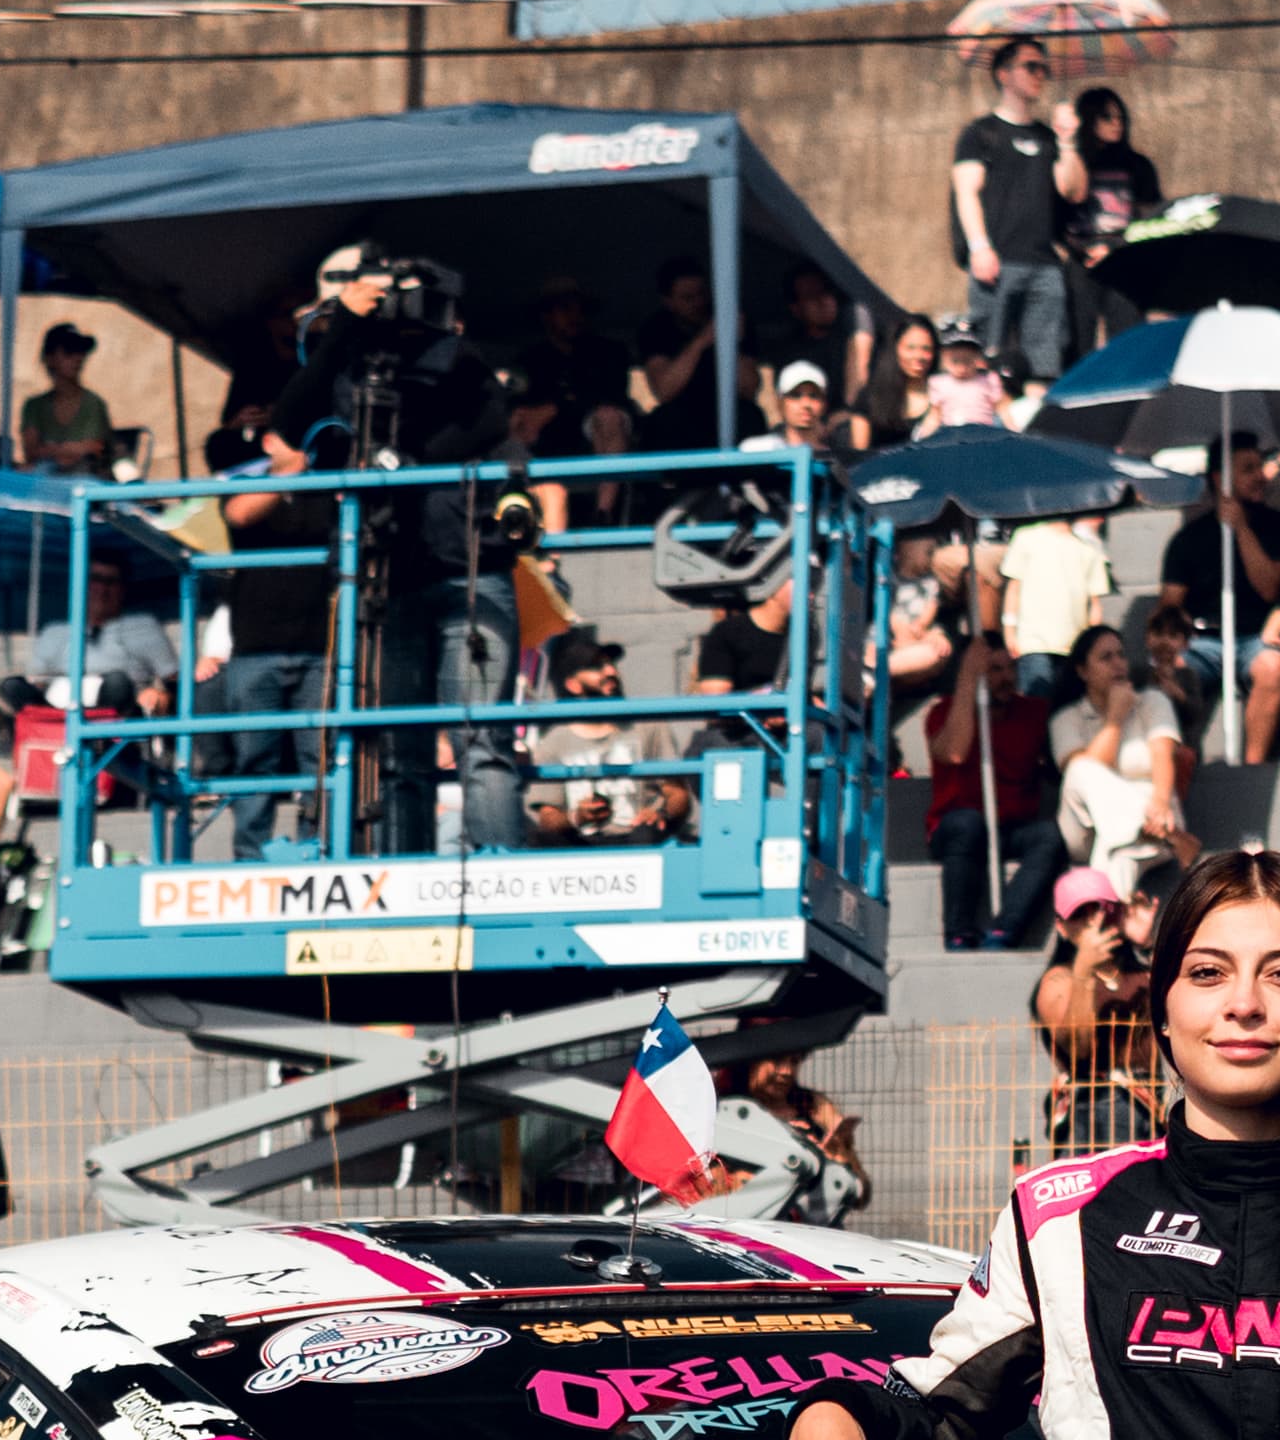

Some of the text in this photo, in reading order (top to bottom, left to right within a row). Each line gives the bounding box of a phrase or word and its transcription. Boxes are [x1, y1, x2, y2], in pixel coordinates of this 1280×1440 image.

[154, 871, 389, 918] PEMTMAX
[418, 873, 524, 902] LOCAÇÃO
[548, 874, 638, 897] VENDAS
[1033, 1174, 1093, 1202] OMP
[1122, 1237, 1217, 1262] ULTIMATE DRIFT
[304, 1315, 384, 1333] USA
[622, 1313, 856, 1331] NUCLEAR
[246, 1328, 510, 1392] American
[380, 1351, 457, 1376] STORE
[526, 1351, 905, 1430] ORELLA
